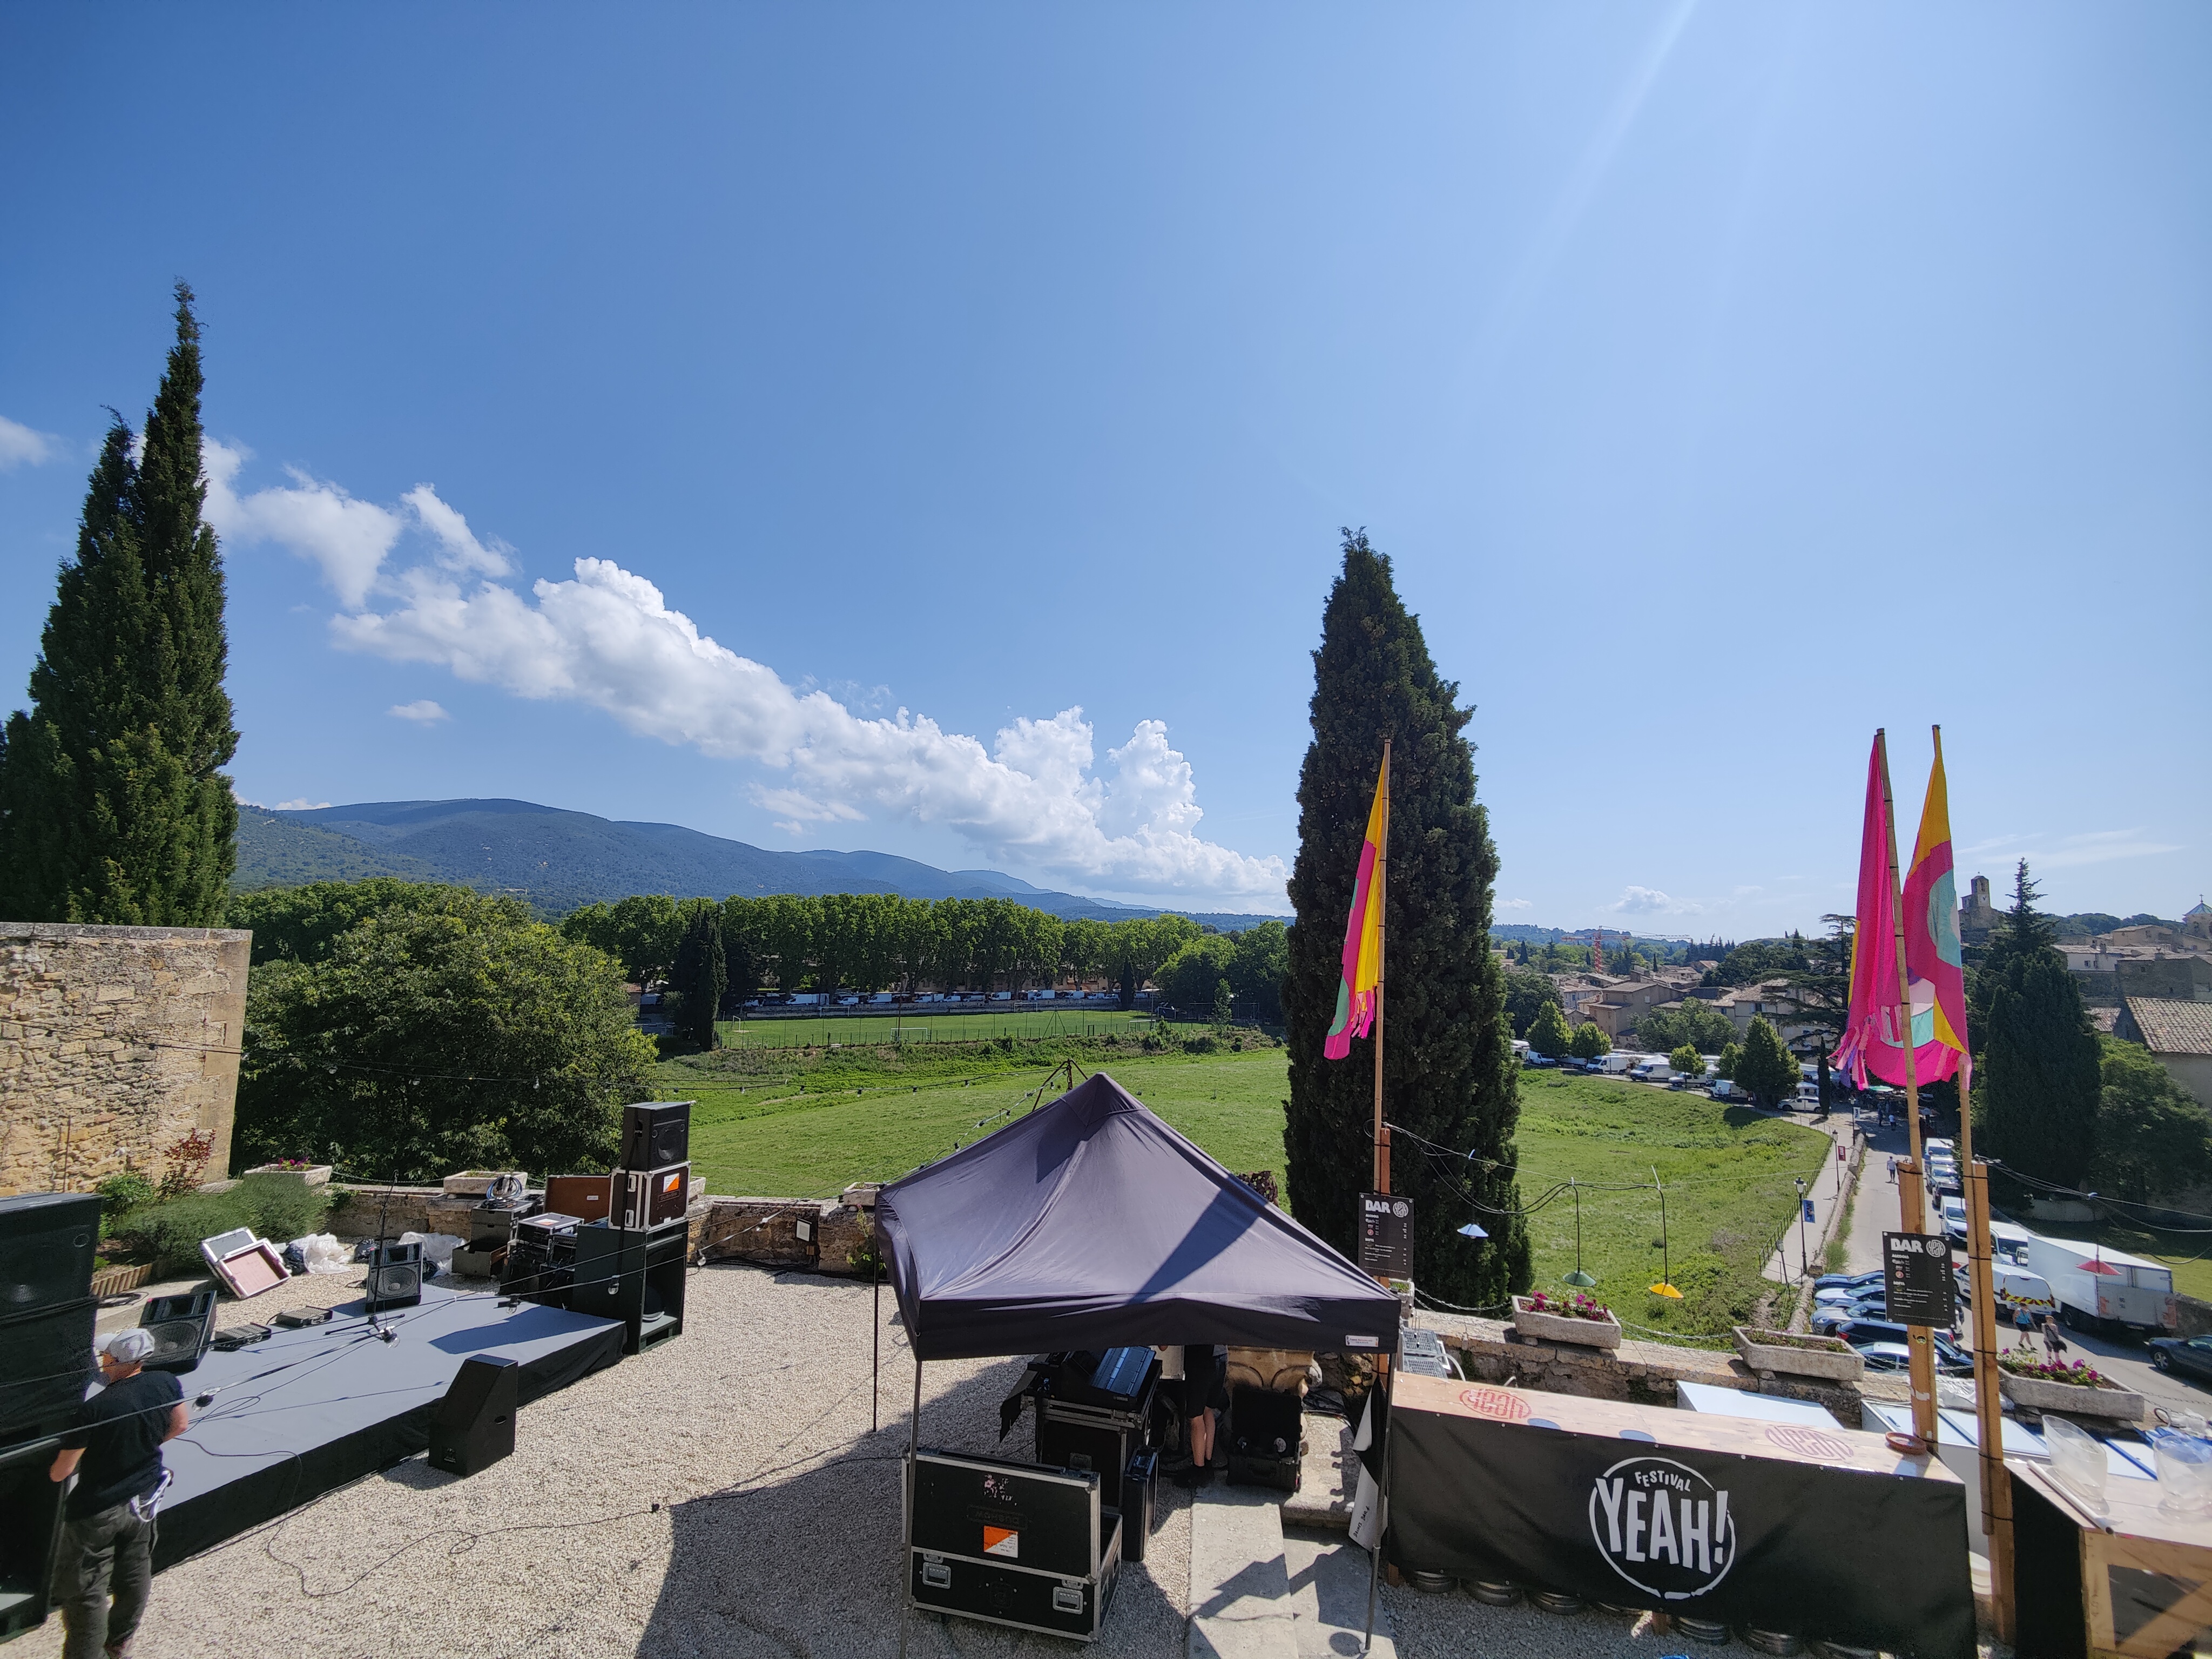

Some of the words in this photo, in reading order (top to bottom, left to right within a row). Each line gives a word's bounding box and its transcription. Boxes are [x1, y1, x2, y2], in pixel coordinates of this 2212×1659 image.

[1365, 1199, 1391, 1213] BAR
[1890, 1238, 1924, 1253] BAR
[1634, 1469, 1691, 1492] FESTIVAL
[1595, 1477, 1729, 1574] YEAH!
